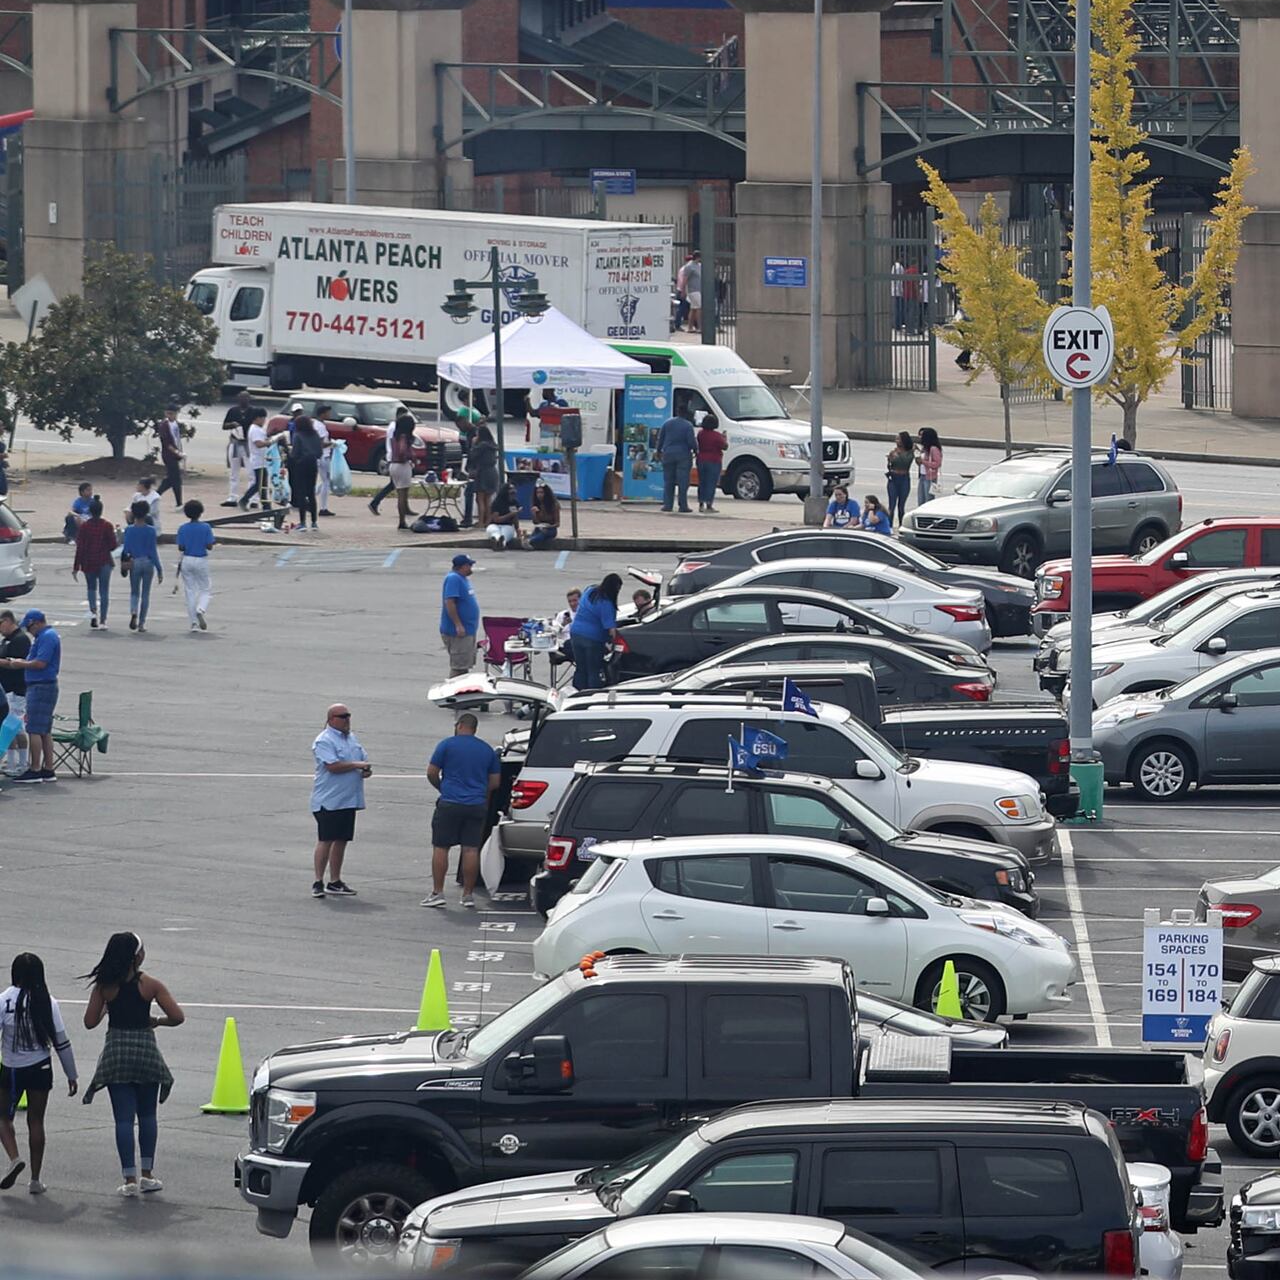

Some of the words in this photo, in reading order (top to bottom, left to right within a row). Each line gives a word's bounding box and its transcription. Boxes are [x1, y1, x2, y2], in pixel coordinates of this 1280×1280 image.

[229, 215, 264, 226] TEACH
[221, 228, 272, 241] CHILDREN
[277, 236, 368, 264] ATLANTA
[375, 242, 442, 269] PEACH
[524, 253, 569, 268] MOVER
[595, 256, 620, 269] ATLANTA
[286, 311, 425, 340] 770-447-5121
[1053, 330, 1103, 350] EXIT
[752, 743, 777, 755] GSU
[1158, 933, 1209, 944] PARKING
[1161, 945, 1206, 955] SPACES
[1147, 963, 1177, 977] 154
[1189, 964, 1219, 977] 170
[1158, 979, 1169, 987] TO
[1147, 989, 1178, 1002] 169
[1187, 989, 1218, 1002] 184
[1110, 1107, 1180, 1122] FX4
